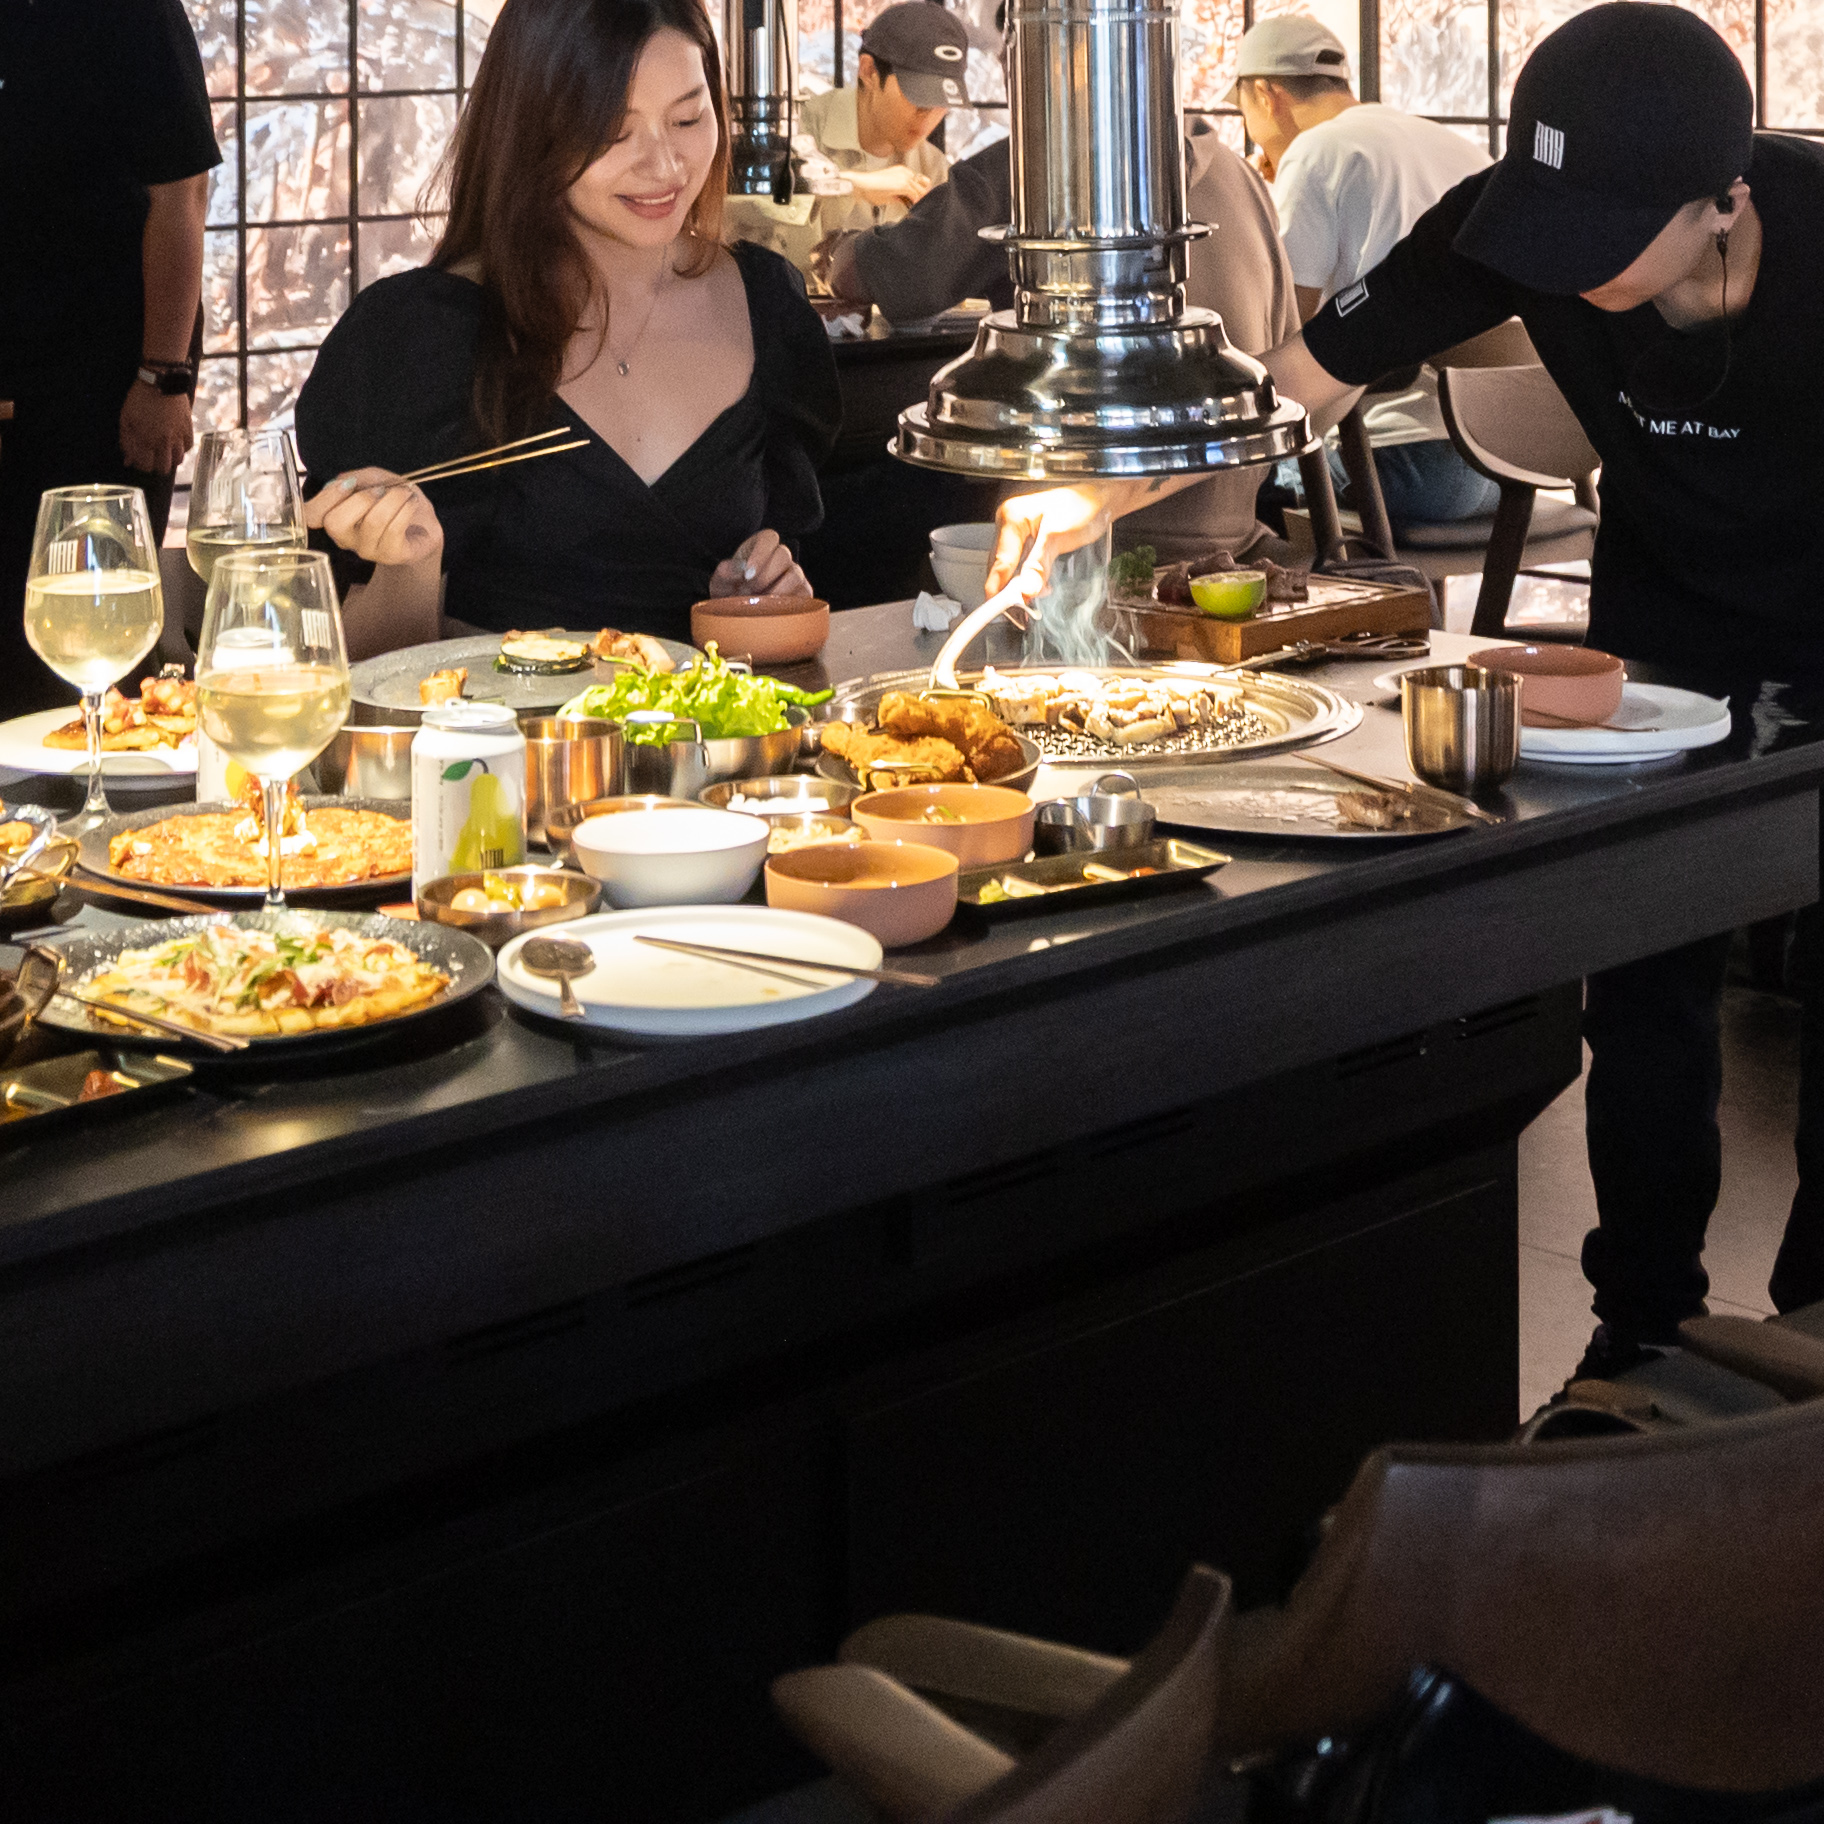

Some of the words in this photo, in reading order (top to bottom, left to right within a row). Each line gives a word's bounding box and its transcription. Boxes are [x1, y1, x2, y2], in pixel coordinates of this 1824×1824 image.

[1649, 418, 1677, 435] ME
[1681, 420, 1704, 435] AT
[1708, 426, 1741, 439] BAY
